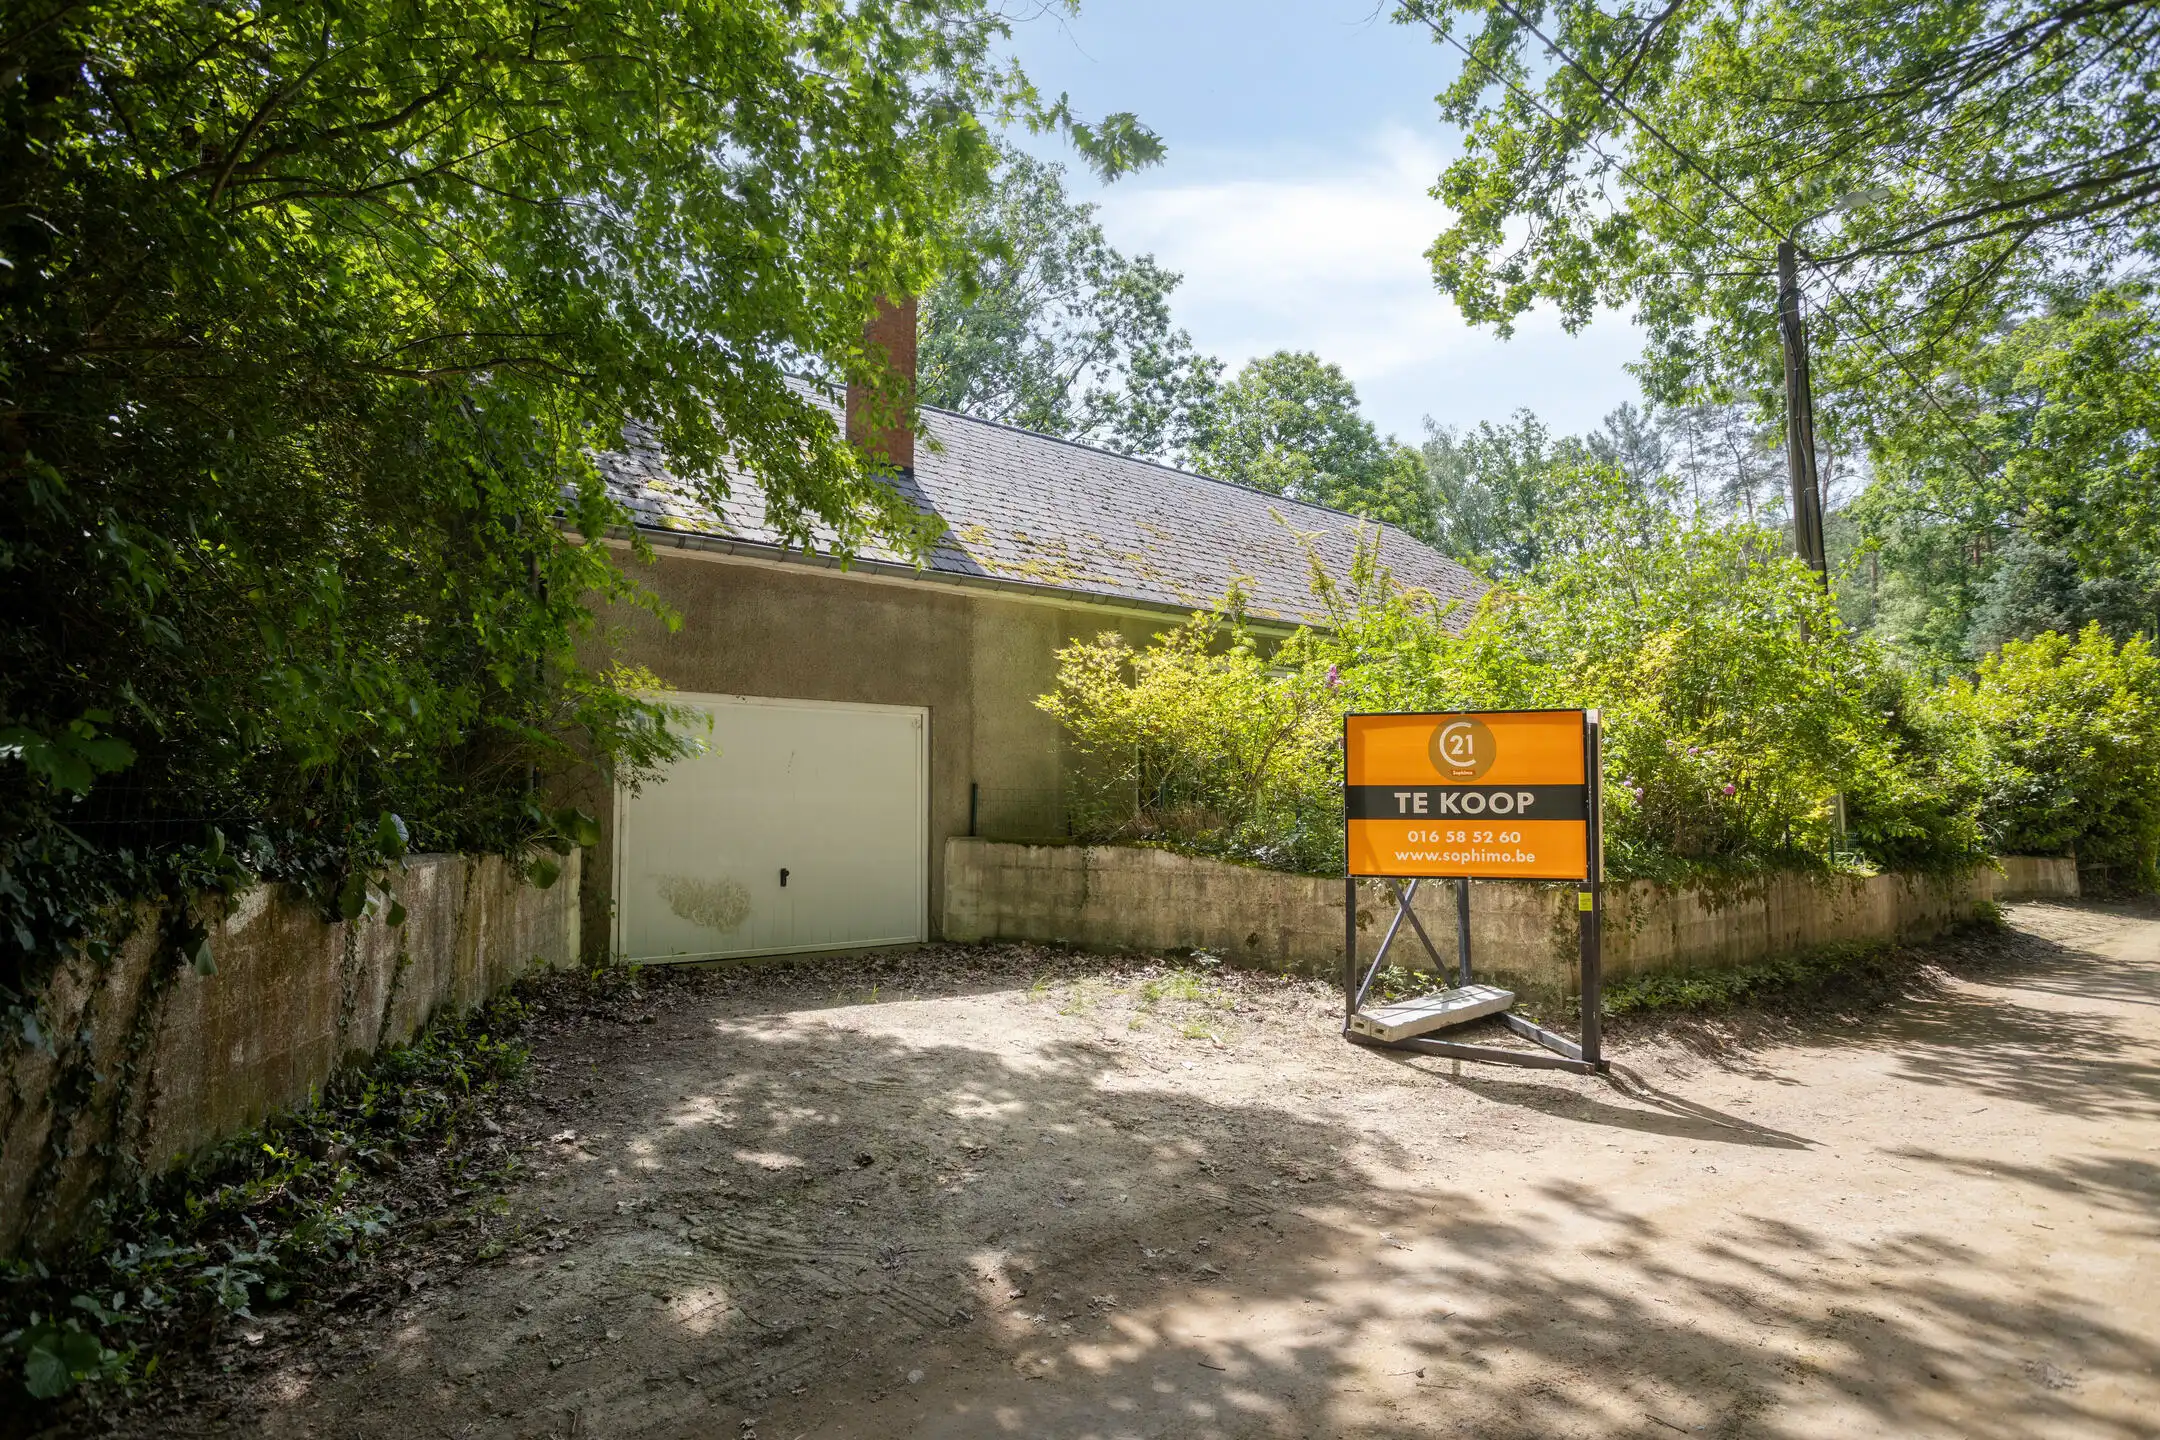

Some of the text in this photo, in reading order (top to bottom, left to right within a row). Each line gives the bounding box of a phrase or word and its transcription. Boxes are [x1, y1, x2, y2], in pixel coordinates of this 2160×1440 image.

[1393, 791, 1535, 815] TE KOOP
[1407, 830, 1521, 844] 016 58 52 60
[1394, 848, 1536, 865] www.sophimo.be
